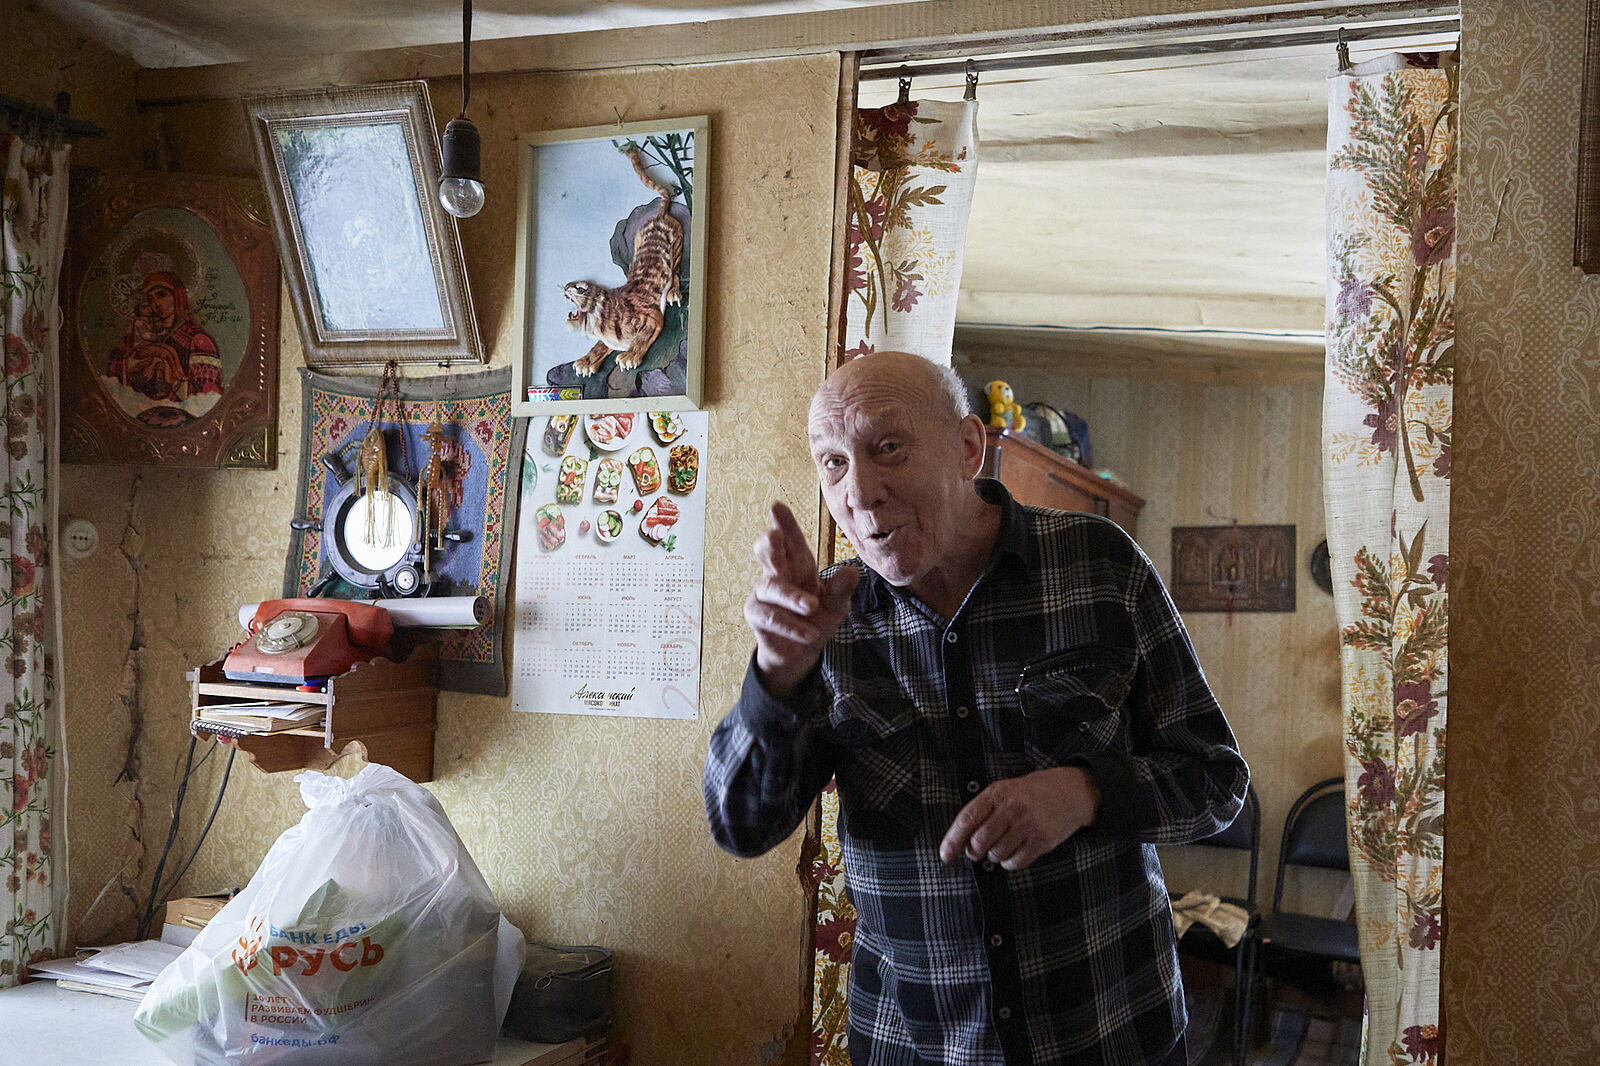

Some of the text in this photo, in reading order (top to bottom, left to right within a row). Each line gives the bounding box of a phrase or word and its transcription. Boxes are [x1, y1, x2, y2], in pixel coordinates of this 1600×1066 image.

[270, 922, 367, 944] БАНК ЕДЫ
[271, 936, 385, 976] РУСЬ
[267, 996, 287, 1004] ЛЕТ
[251, 1004, 311, 1016] РАЗВИВАЕМ
[250, 1015, 307, 1024] В РОССИИ
